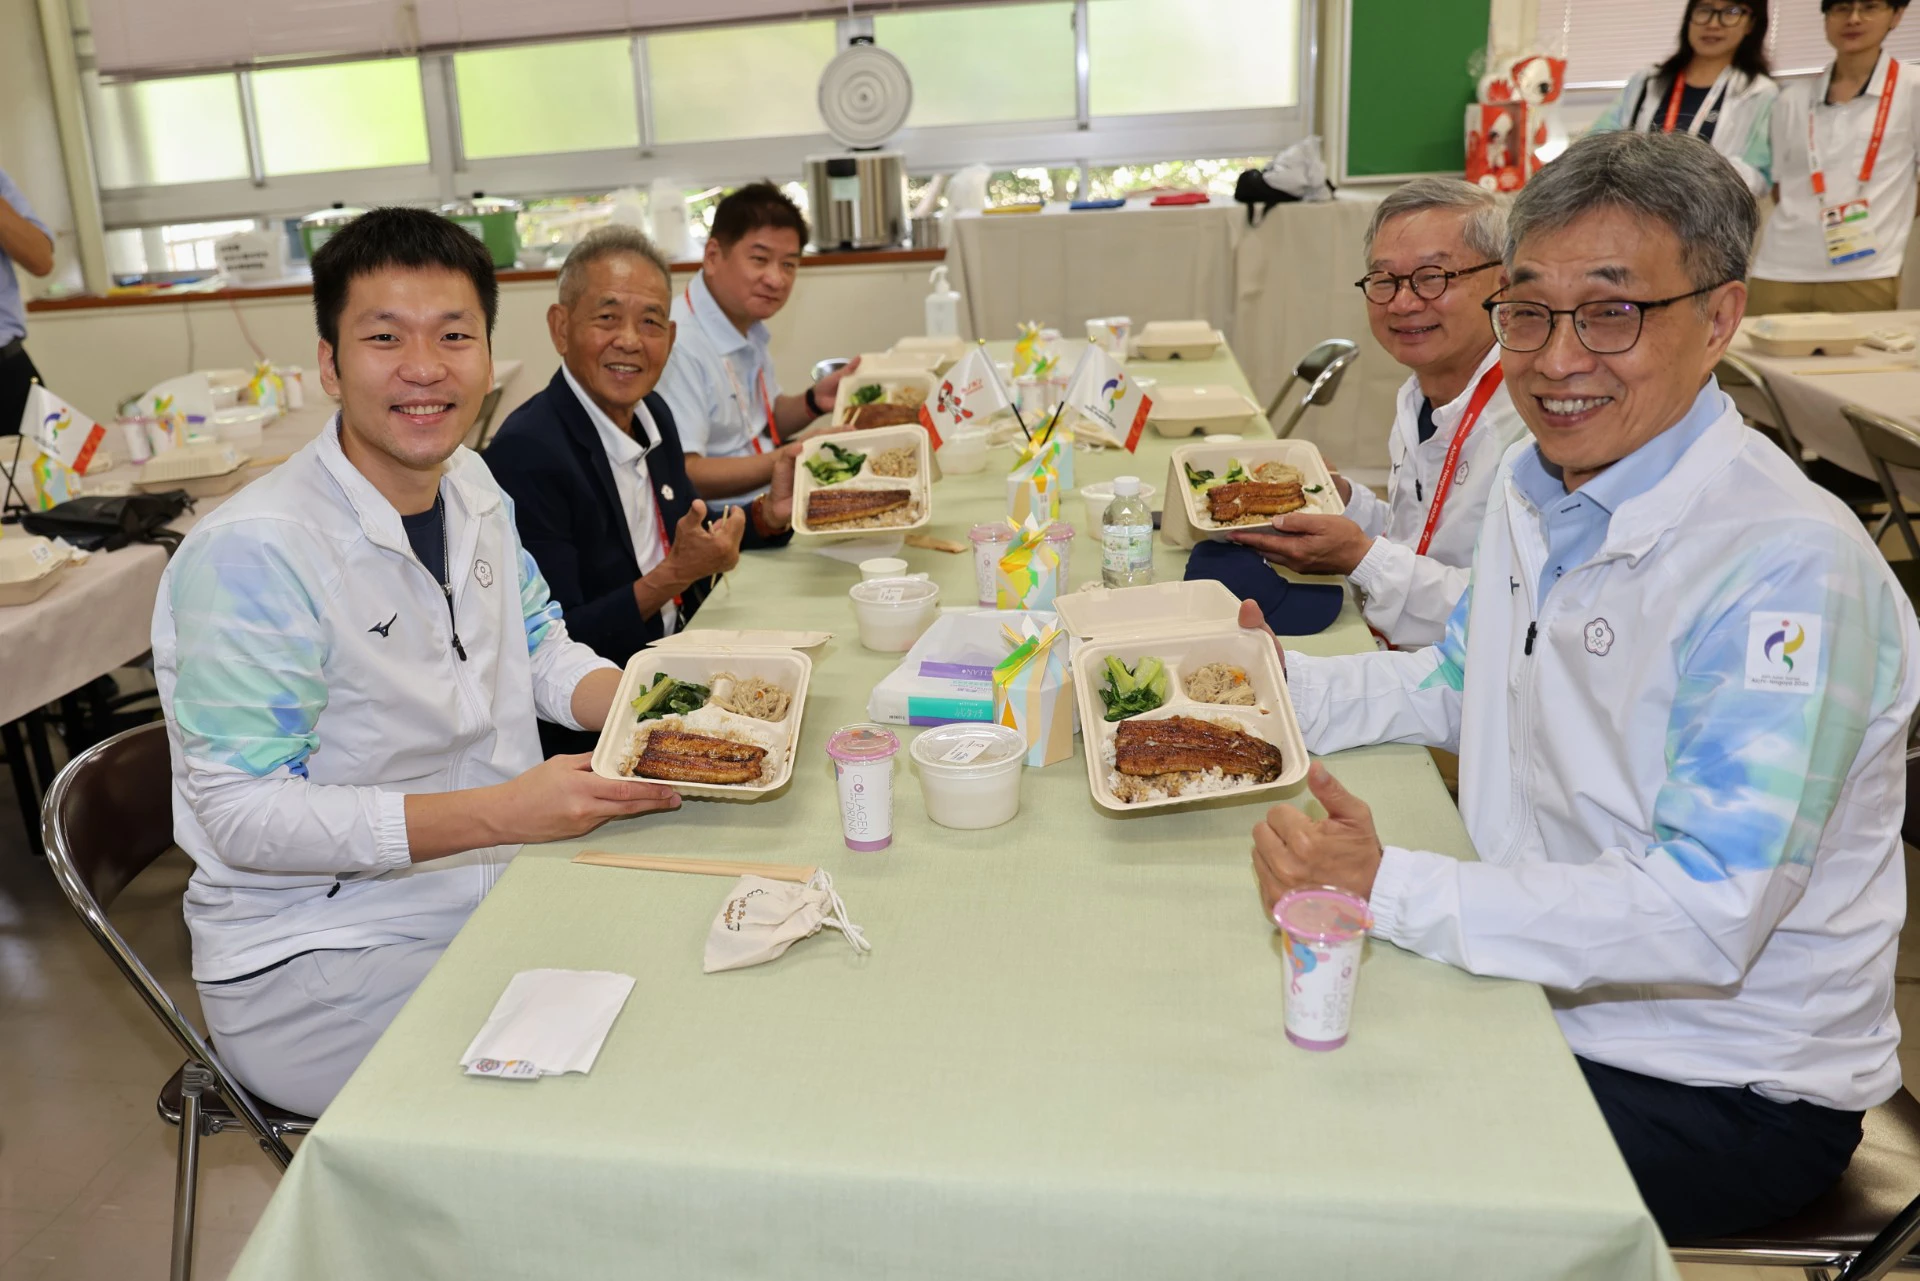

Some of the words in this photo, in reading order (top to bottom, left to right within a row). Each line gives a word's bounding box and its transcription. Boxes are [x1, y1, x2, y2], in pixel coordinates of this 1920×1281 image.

[1436, 444, 1457, 501] Aichi-Nagoya
[846, 801, 857, 833] DRINK
[853, 774, 869, 835] COLLAGEN
